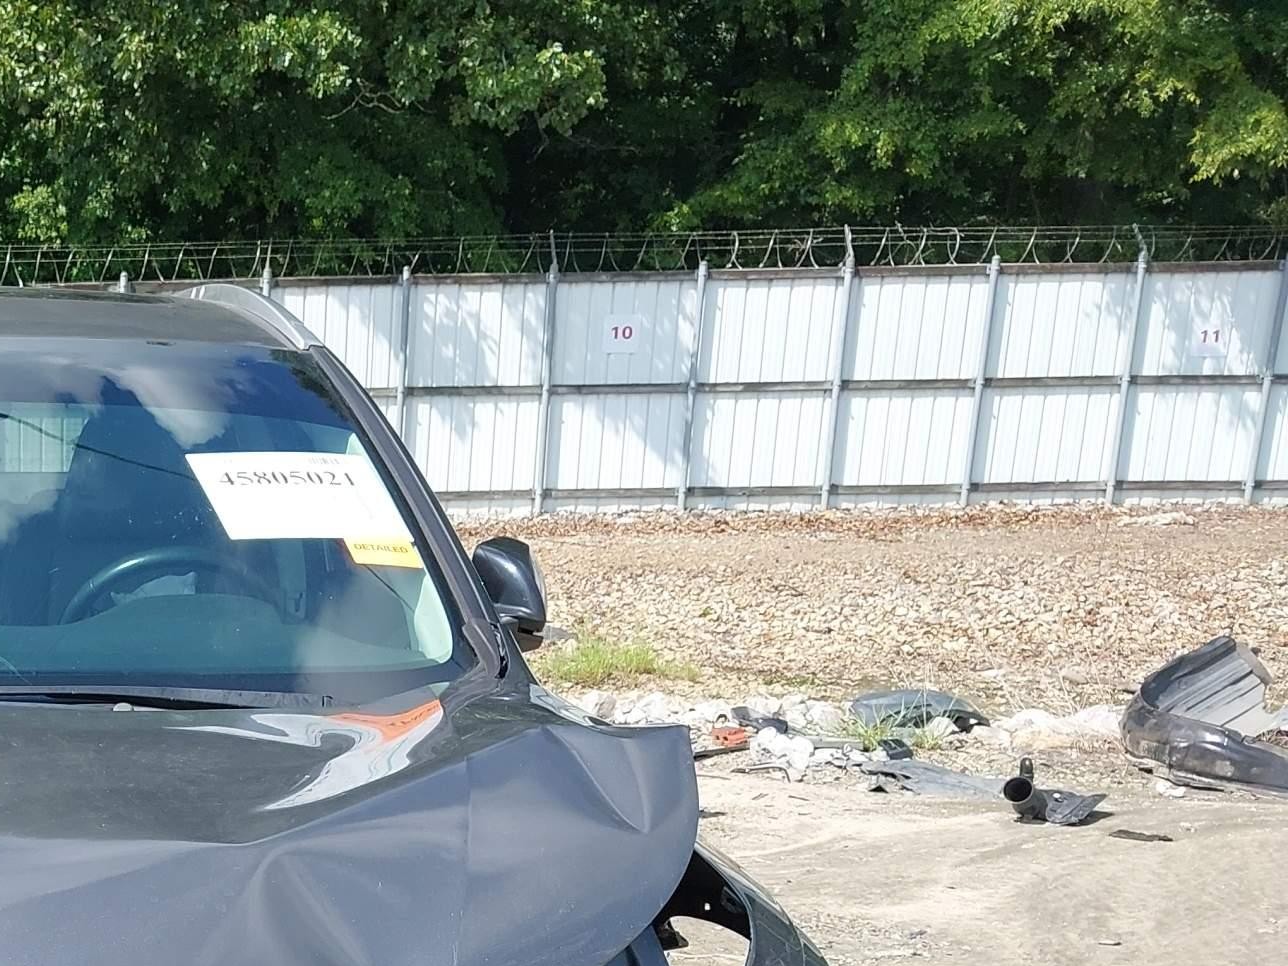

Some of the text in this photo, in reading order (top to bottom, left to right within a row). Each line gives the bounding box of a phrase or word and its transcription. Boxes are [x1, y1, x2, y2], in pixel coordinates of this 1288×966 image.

[612, 326, 632, 339] 10
[1201, 330, 1220, 343] 11
[219, 471, 355, 486] 45805021
[353, 543, 409, 553] DETAILED
